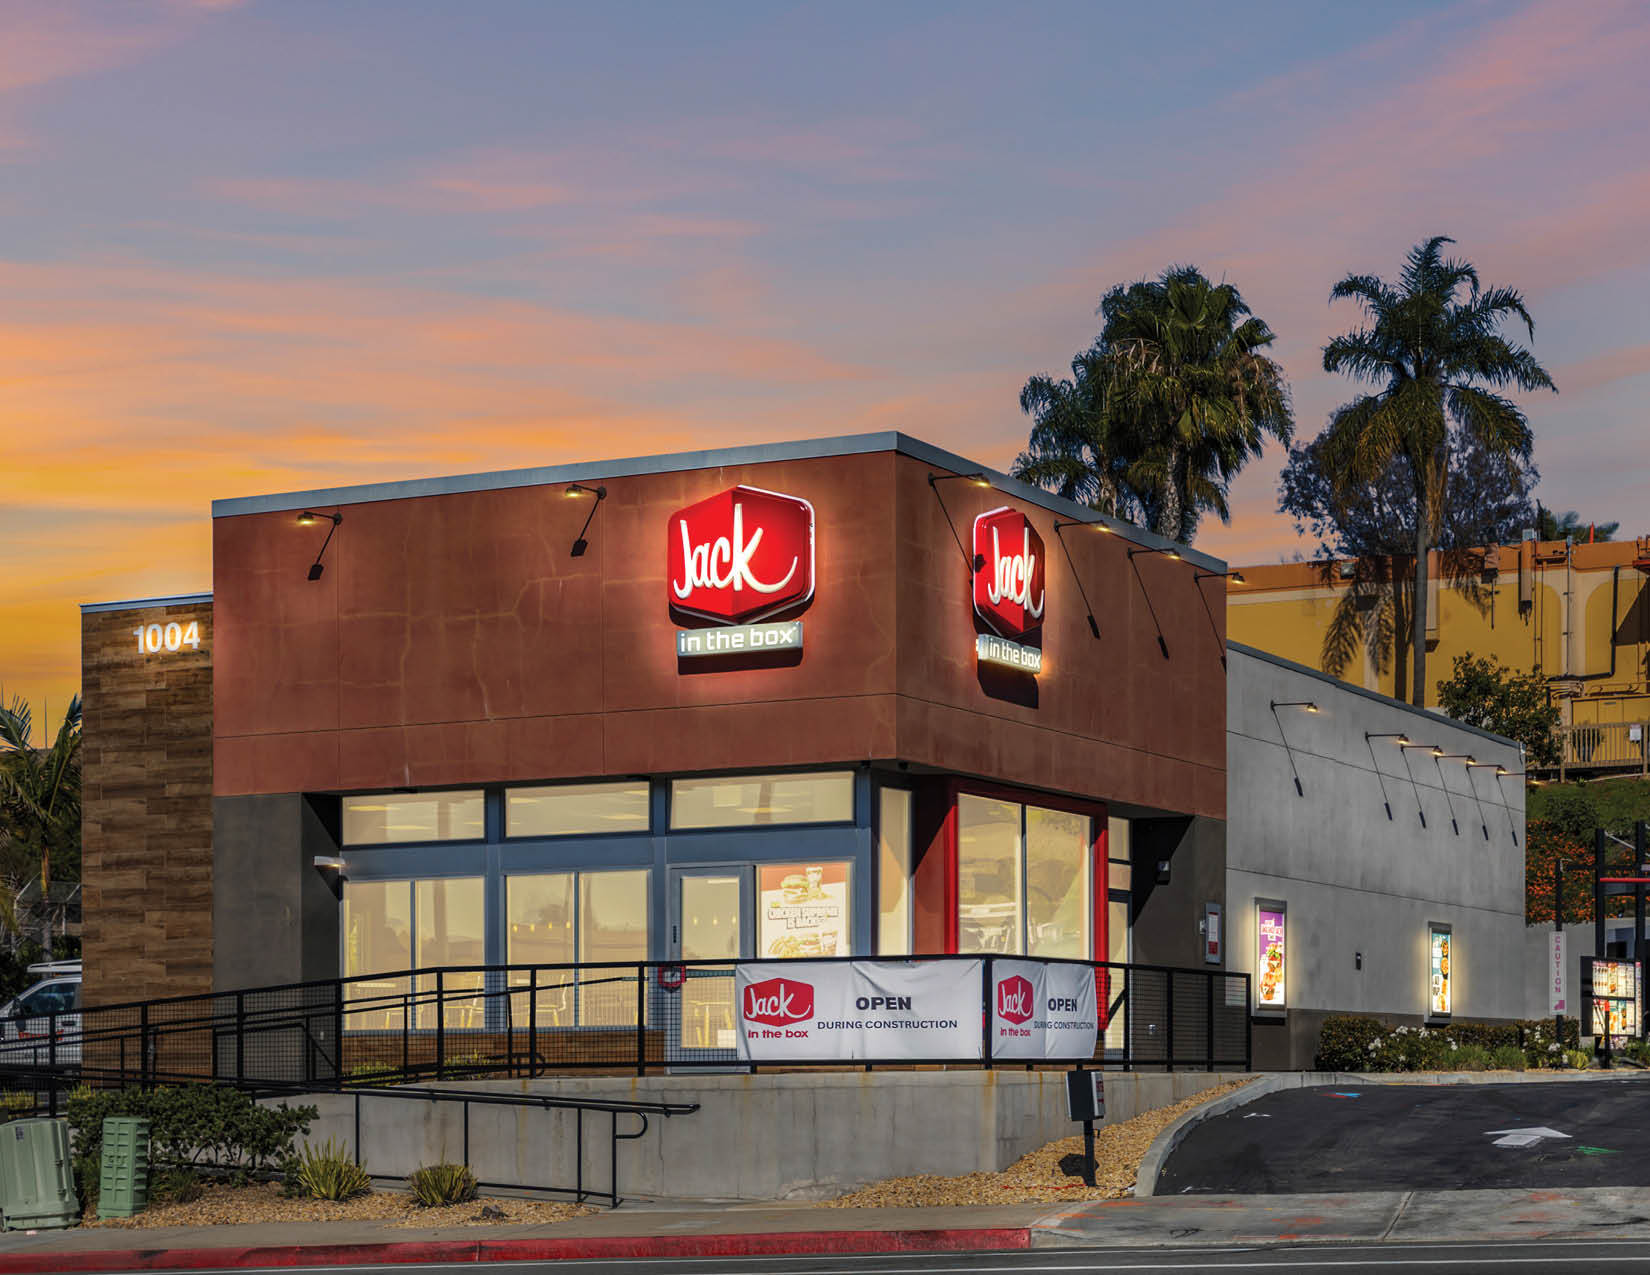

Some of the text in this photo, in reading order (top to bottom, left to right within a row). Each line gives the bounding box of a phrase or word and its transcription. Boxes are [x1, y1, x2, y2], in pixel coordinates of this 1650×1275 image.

[673, 503, 798, 599] Jack
[988, 526, 1045, 618] Jack
[133, 621, 201, 654] 1004
[680, 628, 794, 653] in the box
[989, 638, 1042, 669] in the box
[1554, 935, 1562, 993] CAUTION
[746, 983, 811, 1018] Jack
[856, 997, 912, 1010] OPEN
[999, 981, 1033, 1017] Jack
[1048, 998, 1078, 1012] OPEN
[748, 1028, 808, 1038] in the box
[817, 1020, 958, 1030] DURING CONSTRUCTION
[1000, 1027, 1031, 1037] in the box
[1034, 1021, 1094, 1030] DURING CONSTRUCTION
